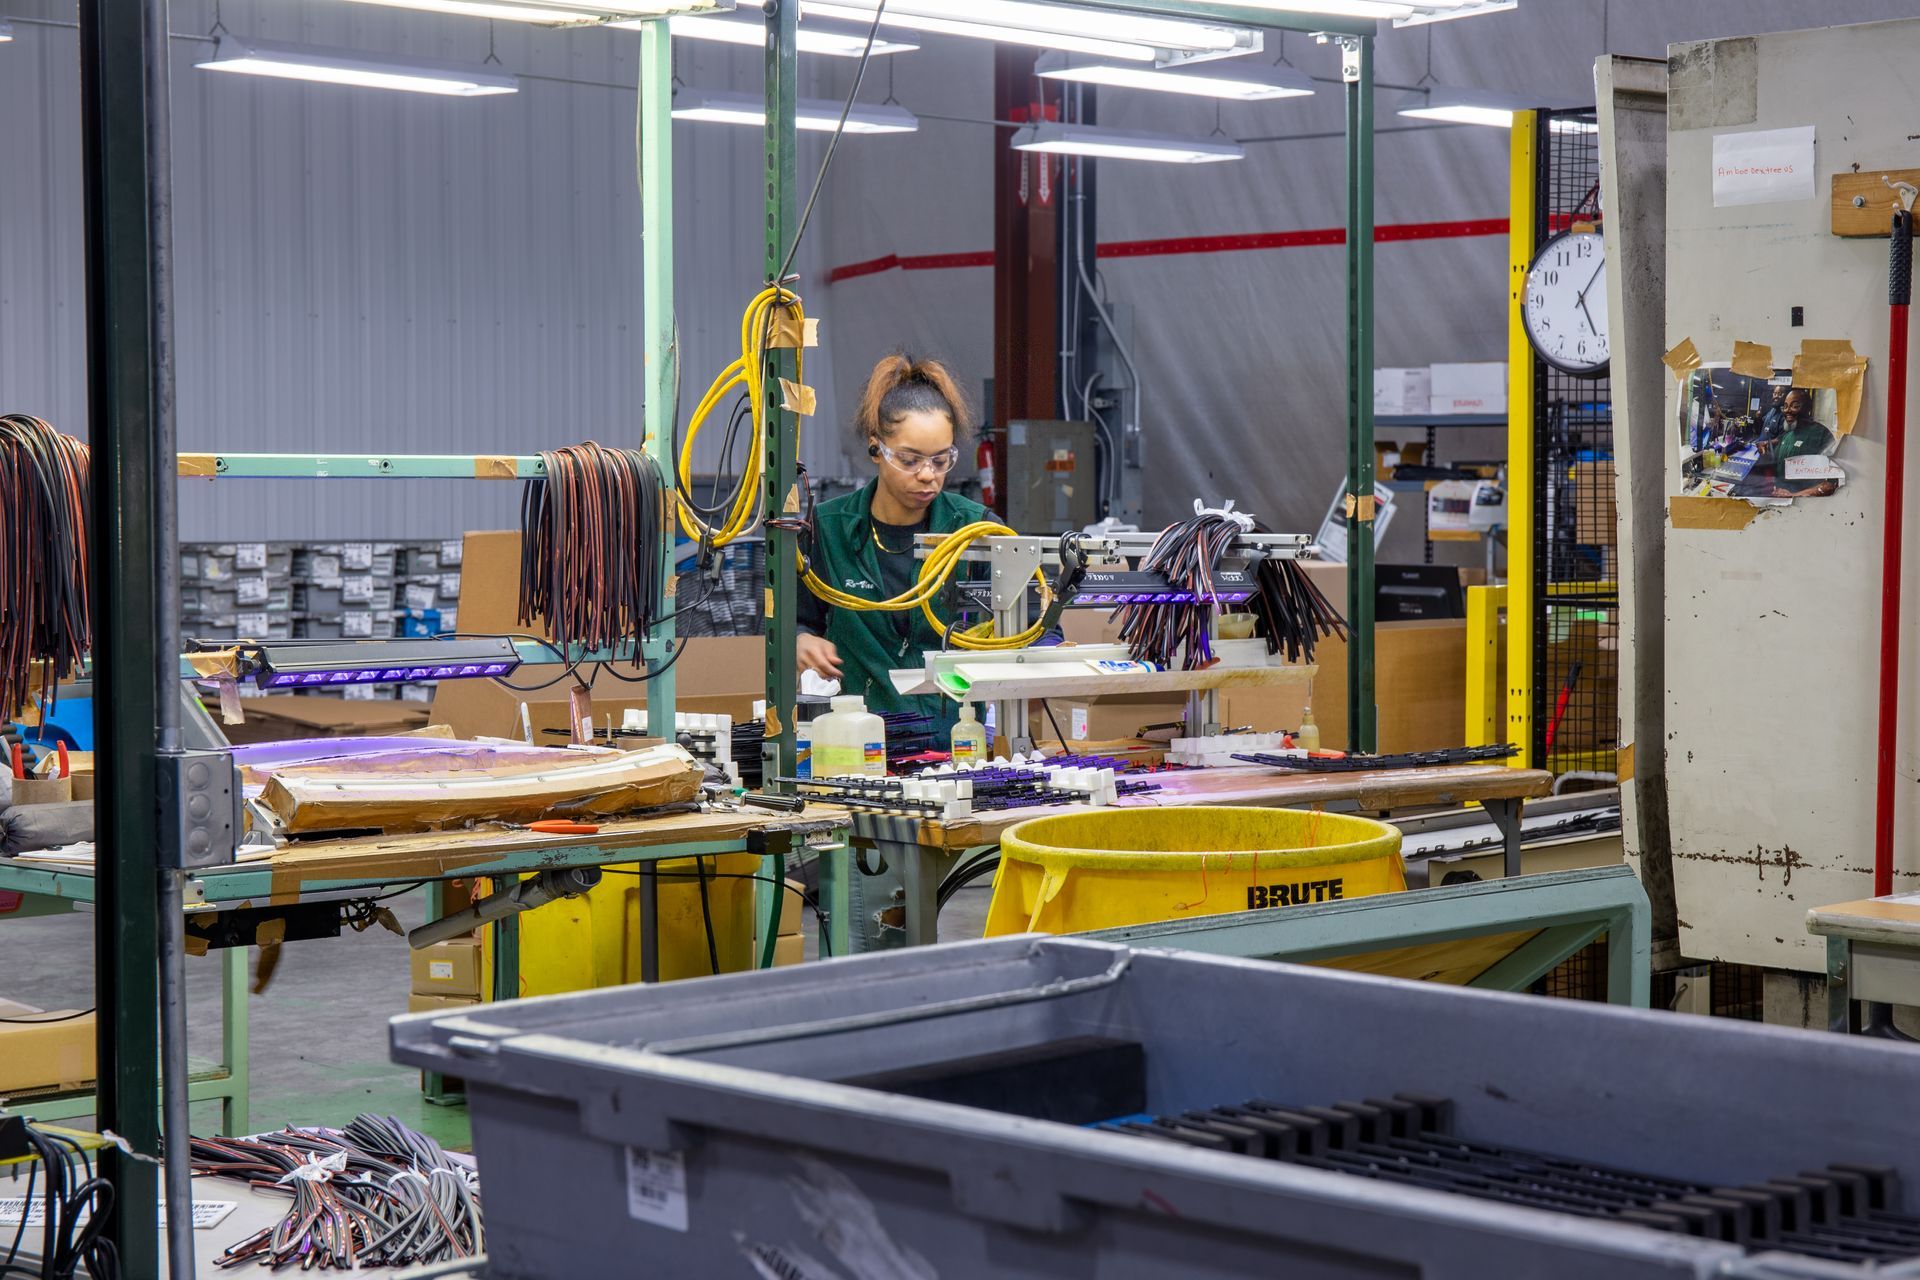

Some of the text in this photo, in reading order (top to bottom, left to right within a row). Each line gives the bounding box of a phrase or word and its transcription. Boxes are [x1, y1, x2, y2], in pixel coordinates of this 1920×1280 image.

[1577, 242, 1591, 258] 12
[1557, 251, 1570, 266] 11
[1544, 270, 1558, 286] 10
[1536, 294, 1544, 309] 9
[1541, 318, 1550, 331] 8
[1559, 335, 1565, 350] 7
[1577, 340, 1585, 355] 6
[1598, 334, 1606, 348] 5
[1247, 878, 1343, 910] BRUTE
